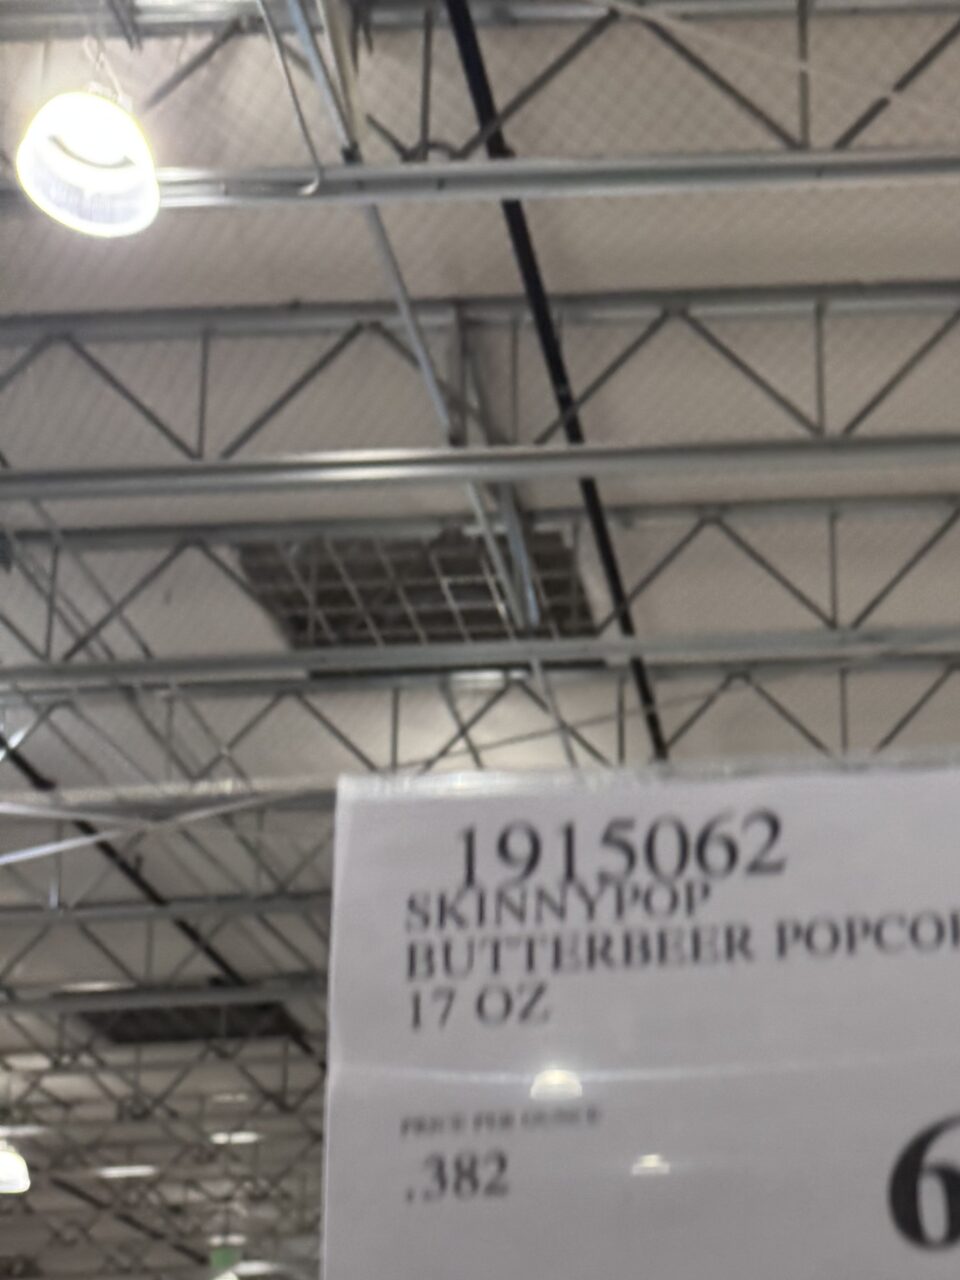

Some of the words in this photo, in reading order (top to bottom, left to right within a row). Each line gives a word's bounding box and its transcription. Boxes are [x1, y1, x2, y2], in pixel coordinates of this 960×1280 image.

[458, 811, 787, 888] 1915062
[406, 877, 711, 932] SKINNYPOP
[407, 922, 753, 980] BUTTERBEER
[411, 987, 456, 1031] 17
[476, 982, 550, 1025] OZ
[405, 1149, 509, 1203] .382
